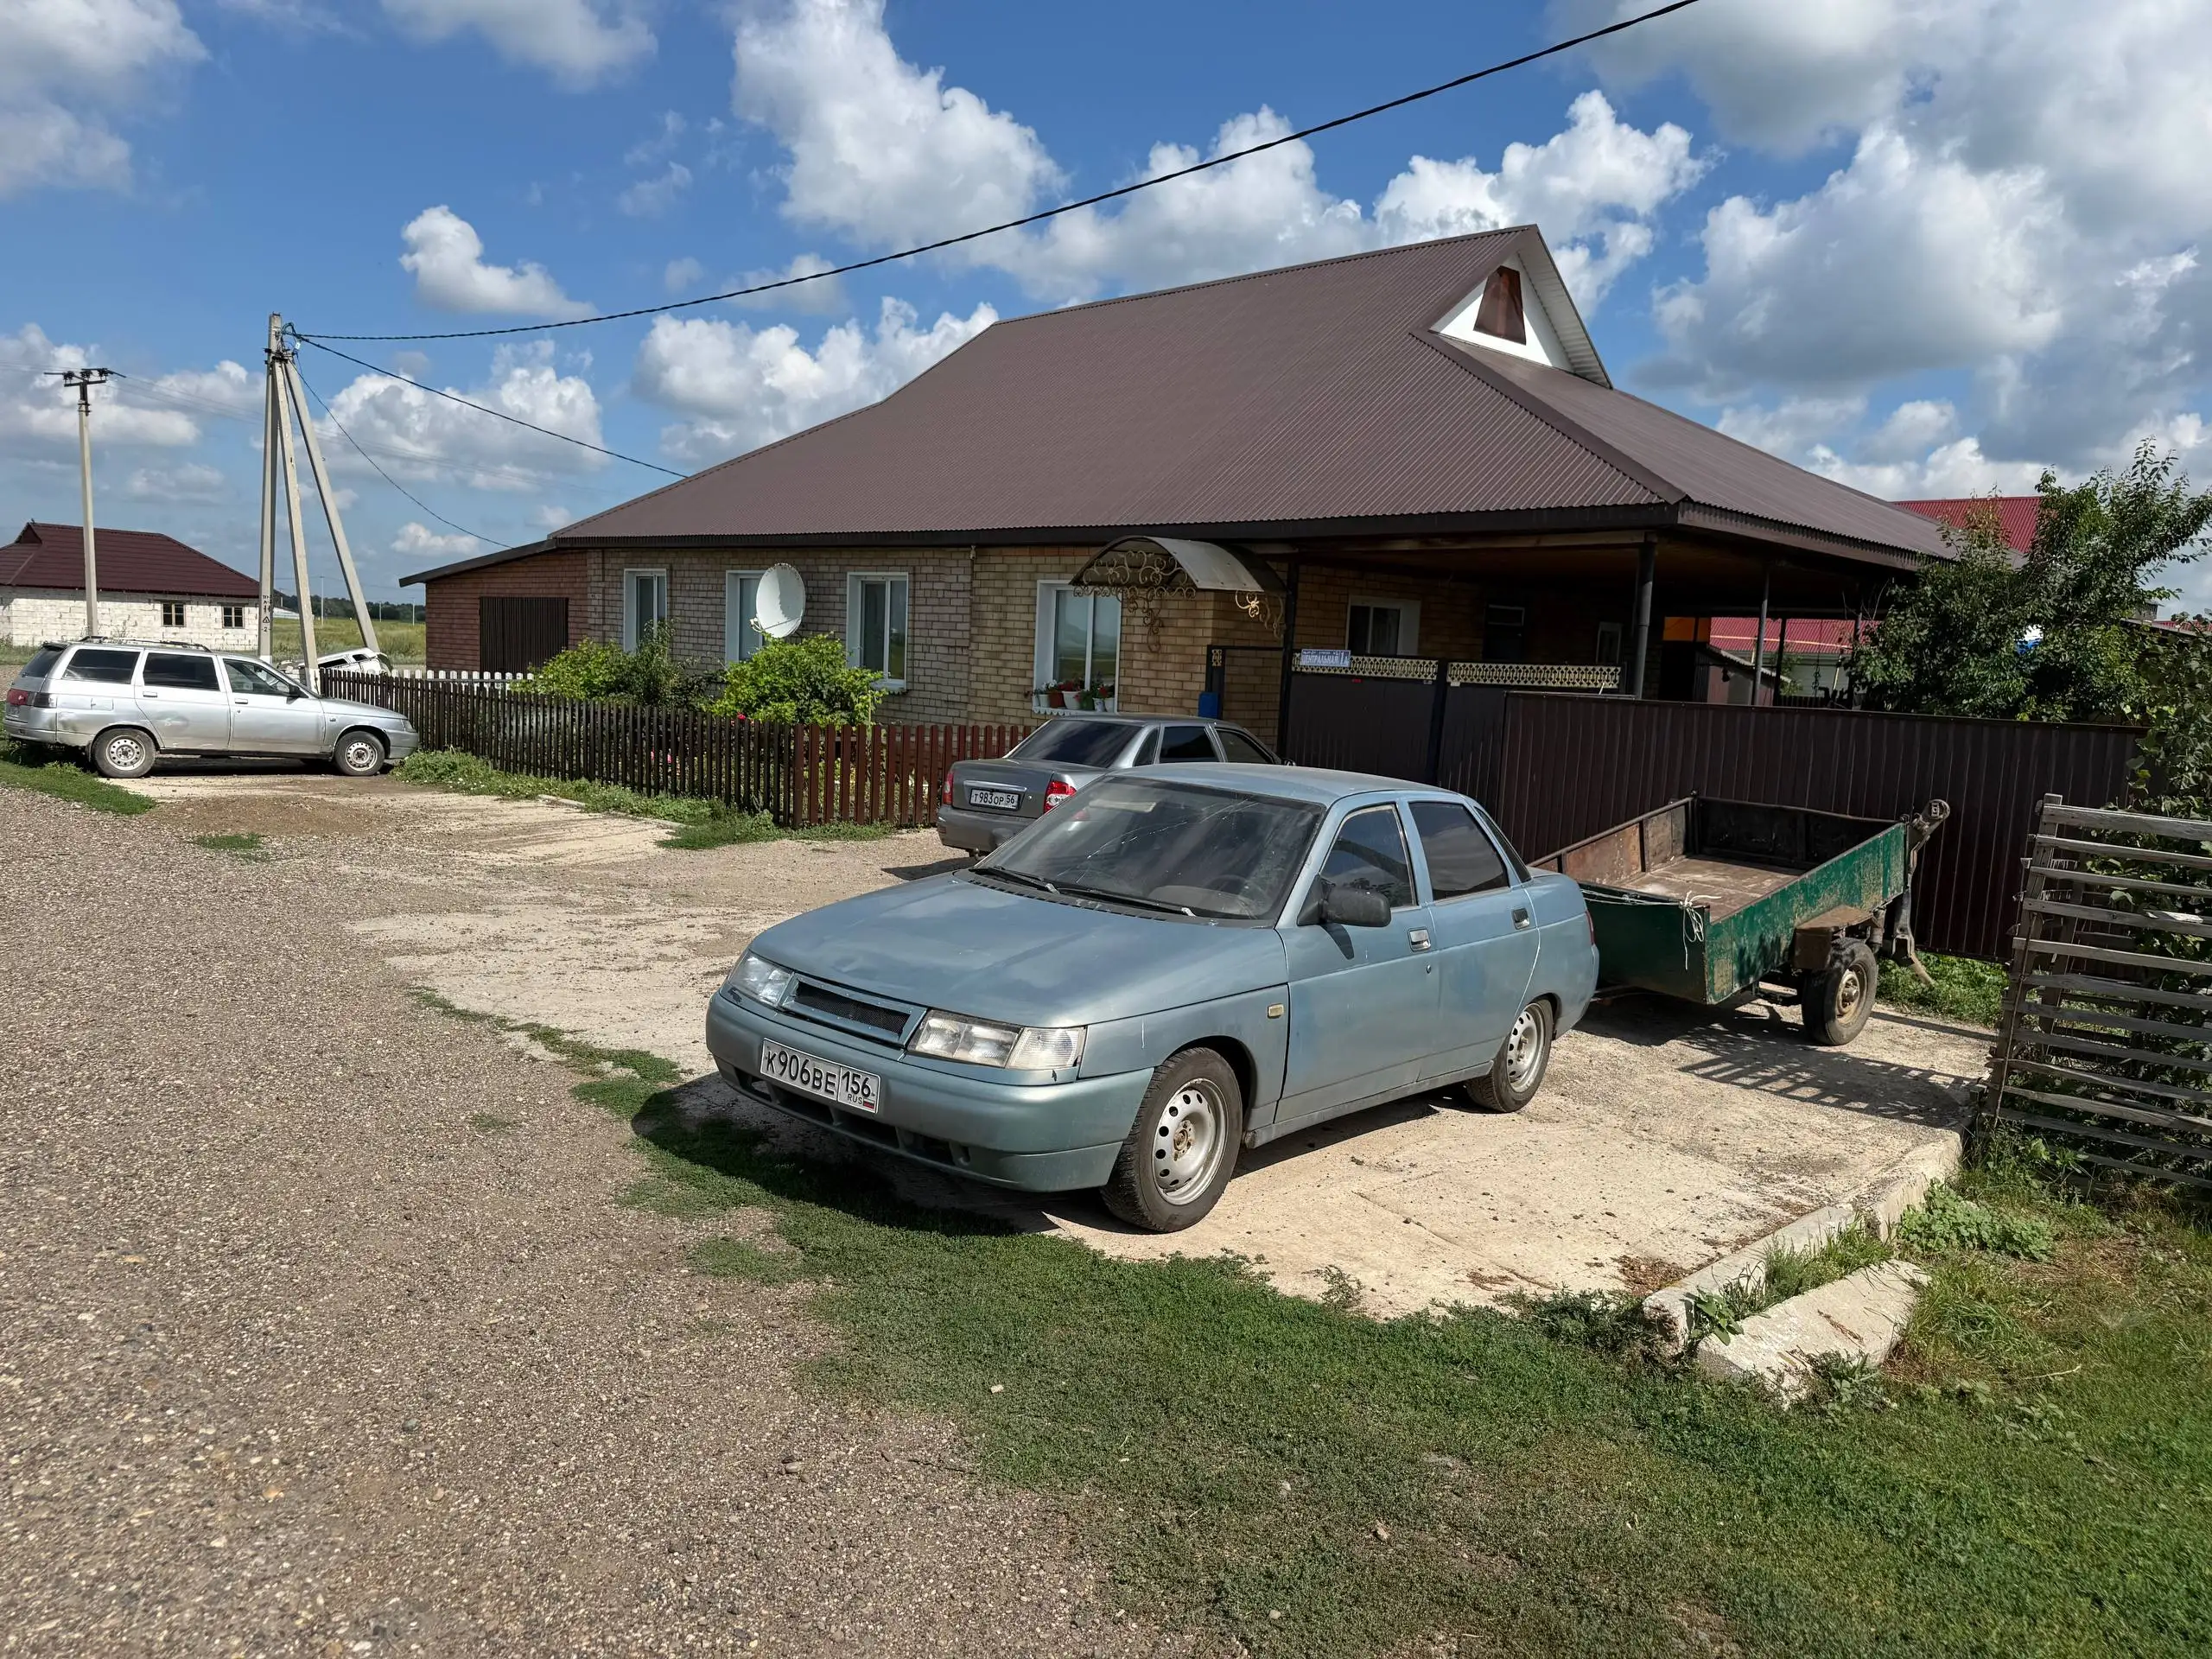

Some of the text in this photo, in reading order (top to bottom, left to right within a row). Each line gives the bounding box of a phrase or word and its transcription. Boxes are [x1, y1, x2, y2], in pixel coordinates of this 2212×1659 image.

[1006, 794, 1015, 804] 56
[766, 1050, 871, 1098] К906ВЕ 156
[847, 1092, 863, 1105] RUS
